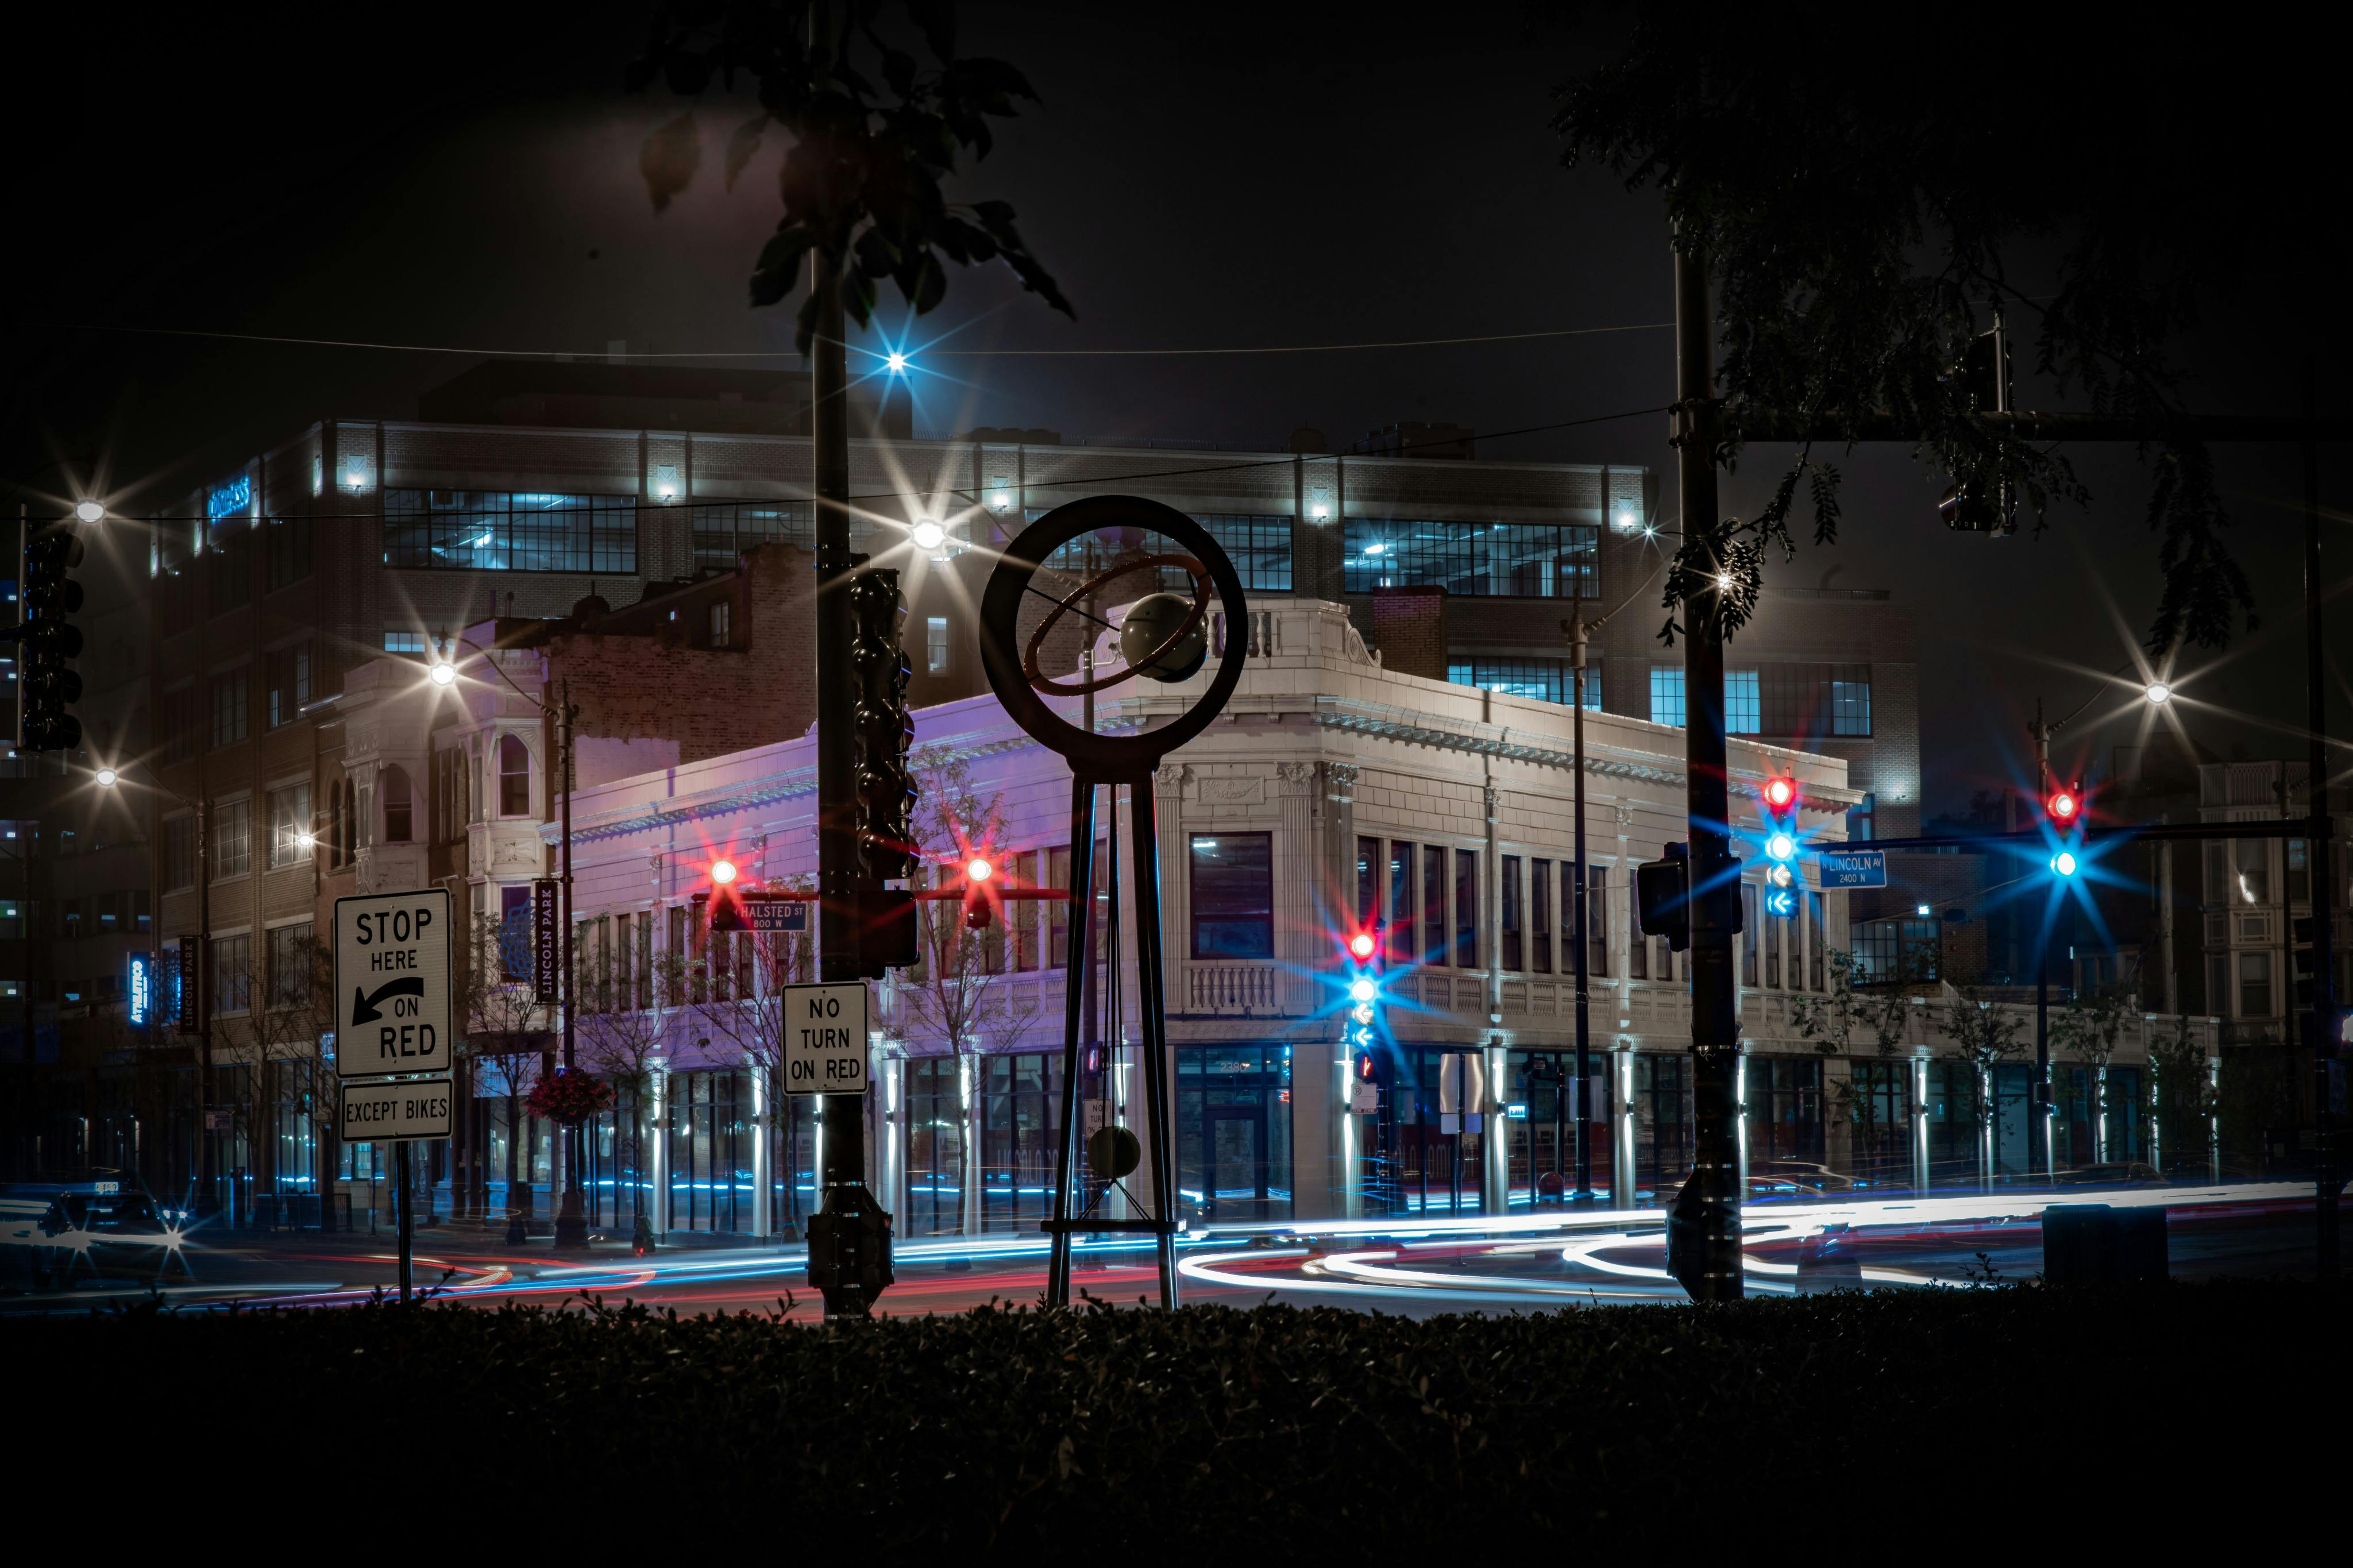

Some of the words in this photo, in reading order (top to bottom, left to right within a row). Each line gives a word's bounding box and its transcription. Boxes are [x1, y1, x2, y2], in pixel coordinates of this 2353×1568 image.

[1829, 857, 1872, 871] LINCOLN
[1873, 858, 1881, 867] AV
[1839, 874, 1857, 883] 2400
[1860, 874, 1866, 883] N
[542, 889, 552, 925] PARK
[741, 906, 791, 917] HALSTED
[794, 907, 803, 916] ST
[356, 909, 432, 945] STOP
[372, 949, 418, 971] HERE
[542, 930, 552, 995] LINCOLN
[395, 998, 418, 1017] ON
[810, 998, 839, 1018] NO
[380, 1024, 436, 1058] RED
[801, 1028, 849, 1049] TURN
[792, 1060, 815, 1080] ON
[827, 1059, 859, 1079] RED
[1220, 1063, 1247, 1072] 2380
[346, 1101, 398, 1122] EXCEPT
[406, 1098, 447, 1119] BIKES
